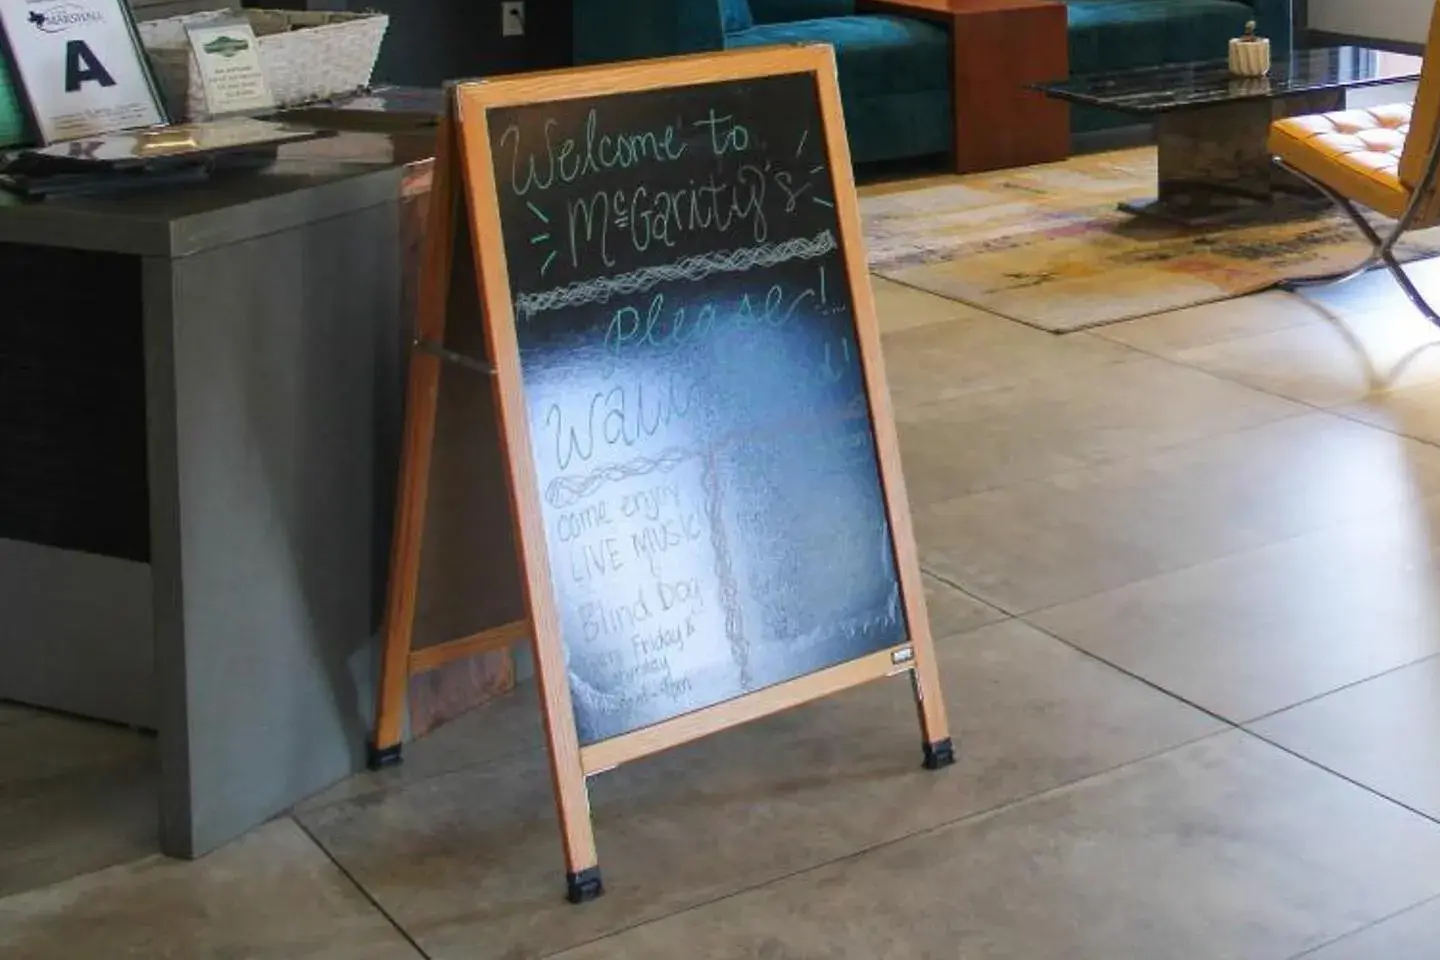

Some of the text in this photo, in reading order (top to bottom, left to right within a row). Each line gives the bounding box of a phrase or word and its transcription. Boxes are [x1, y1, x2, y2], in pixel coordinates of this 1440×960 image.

[64, 39, 117, 93] A
[499, 107, 750, 196] Welcome to
[571, 538, 624, 582] LIVE
[631, 624, 684, 656] Friday
